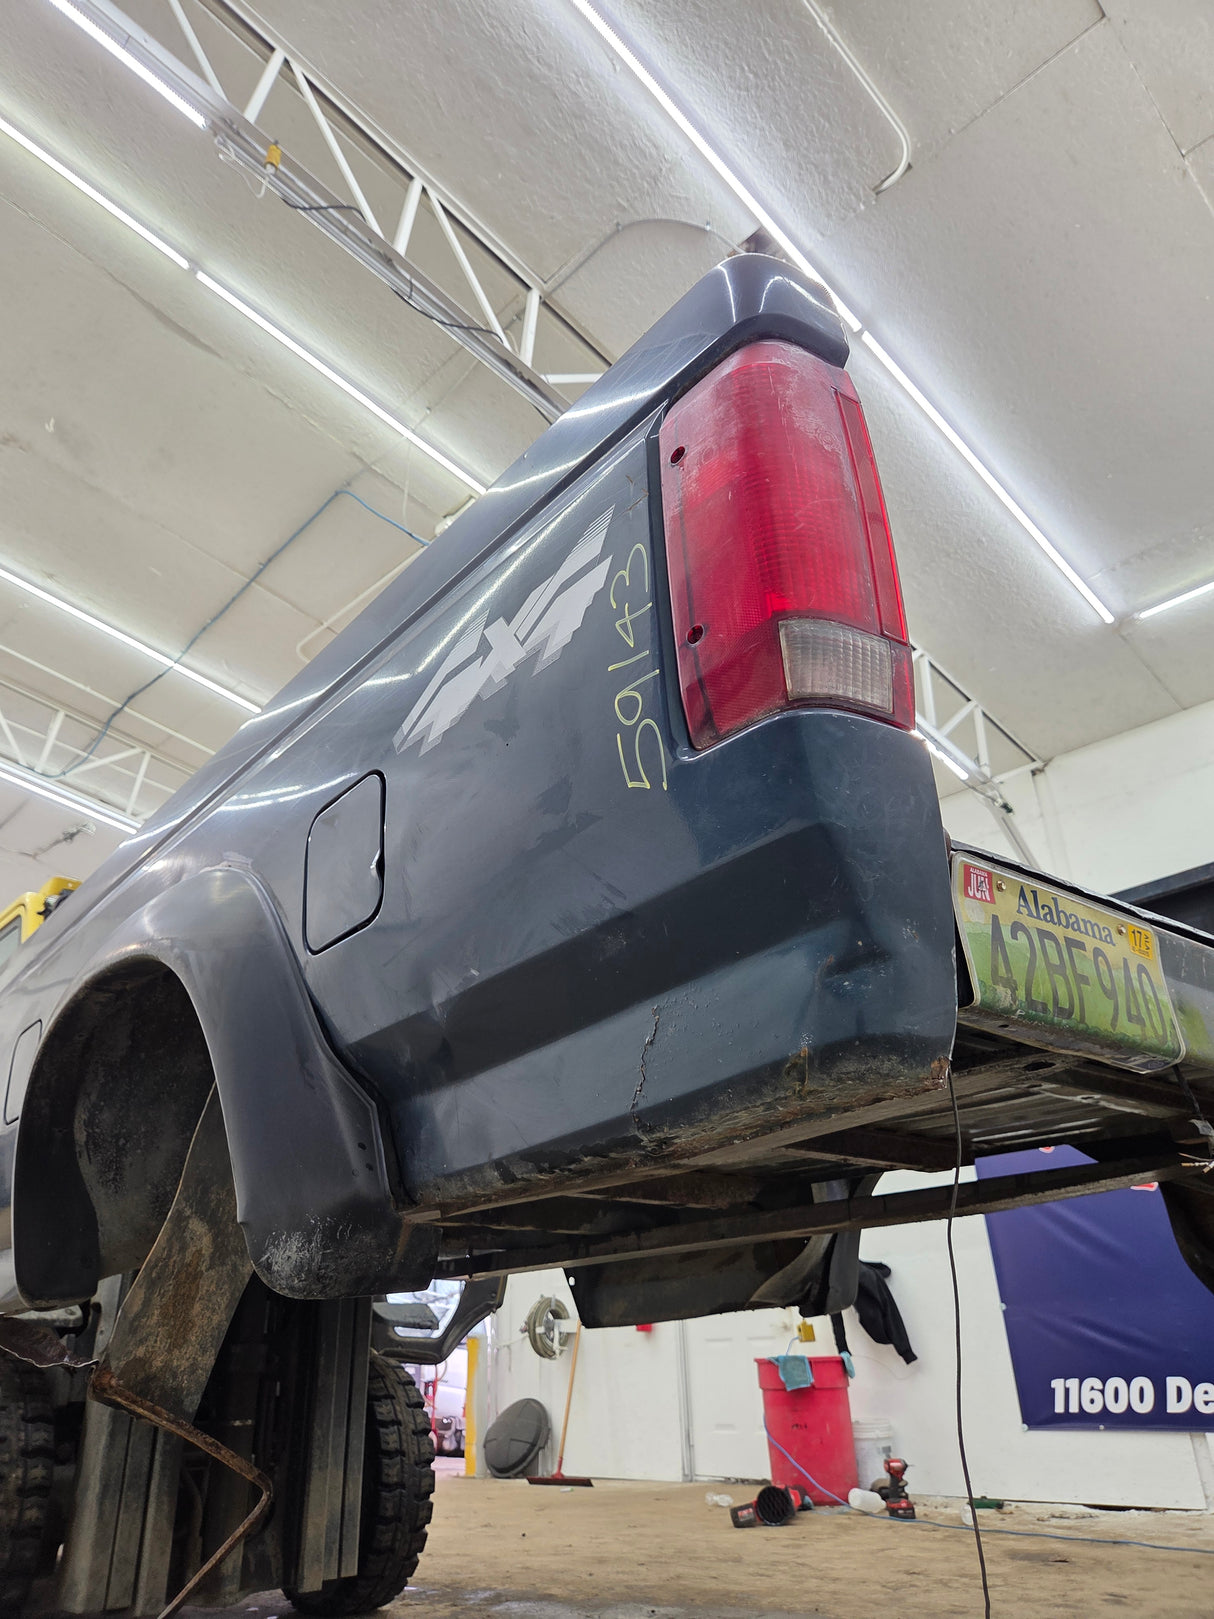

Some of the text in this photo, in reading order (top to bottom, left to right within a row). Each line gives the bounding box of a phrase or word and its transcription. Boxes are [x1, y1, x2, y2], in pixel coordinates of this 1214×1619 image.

[608, 543, 668, 791] 59143
[967, 873, 990, 901] JUN
[1016, 885, 1116, 947] Alabama
[1131, 929, 1142, 948] 17
[990, 914, 1168, 1046] 42BF940
[1050, 1376, 1155, 1414] 11600
